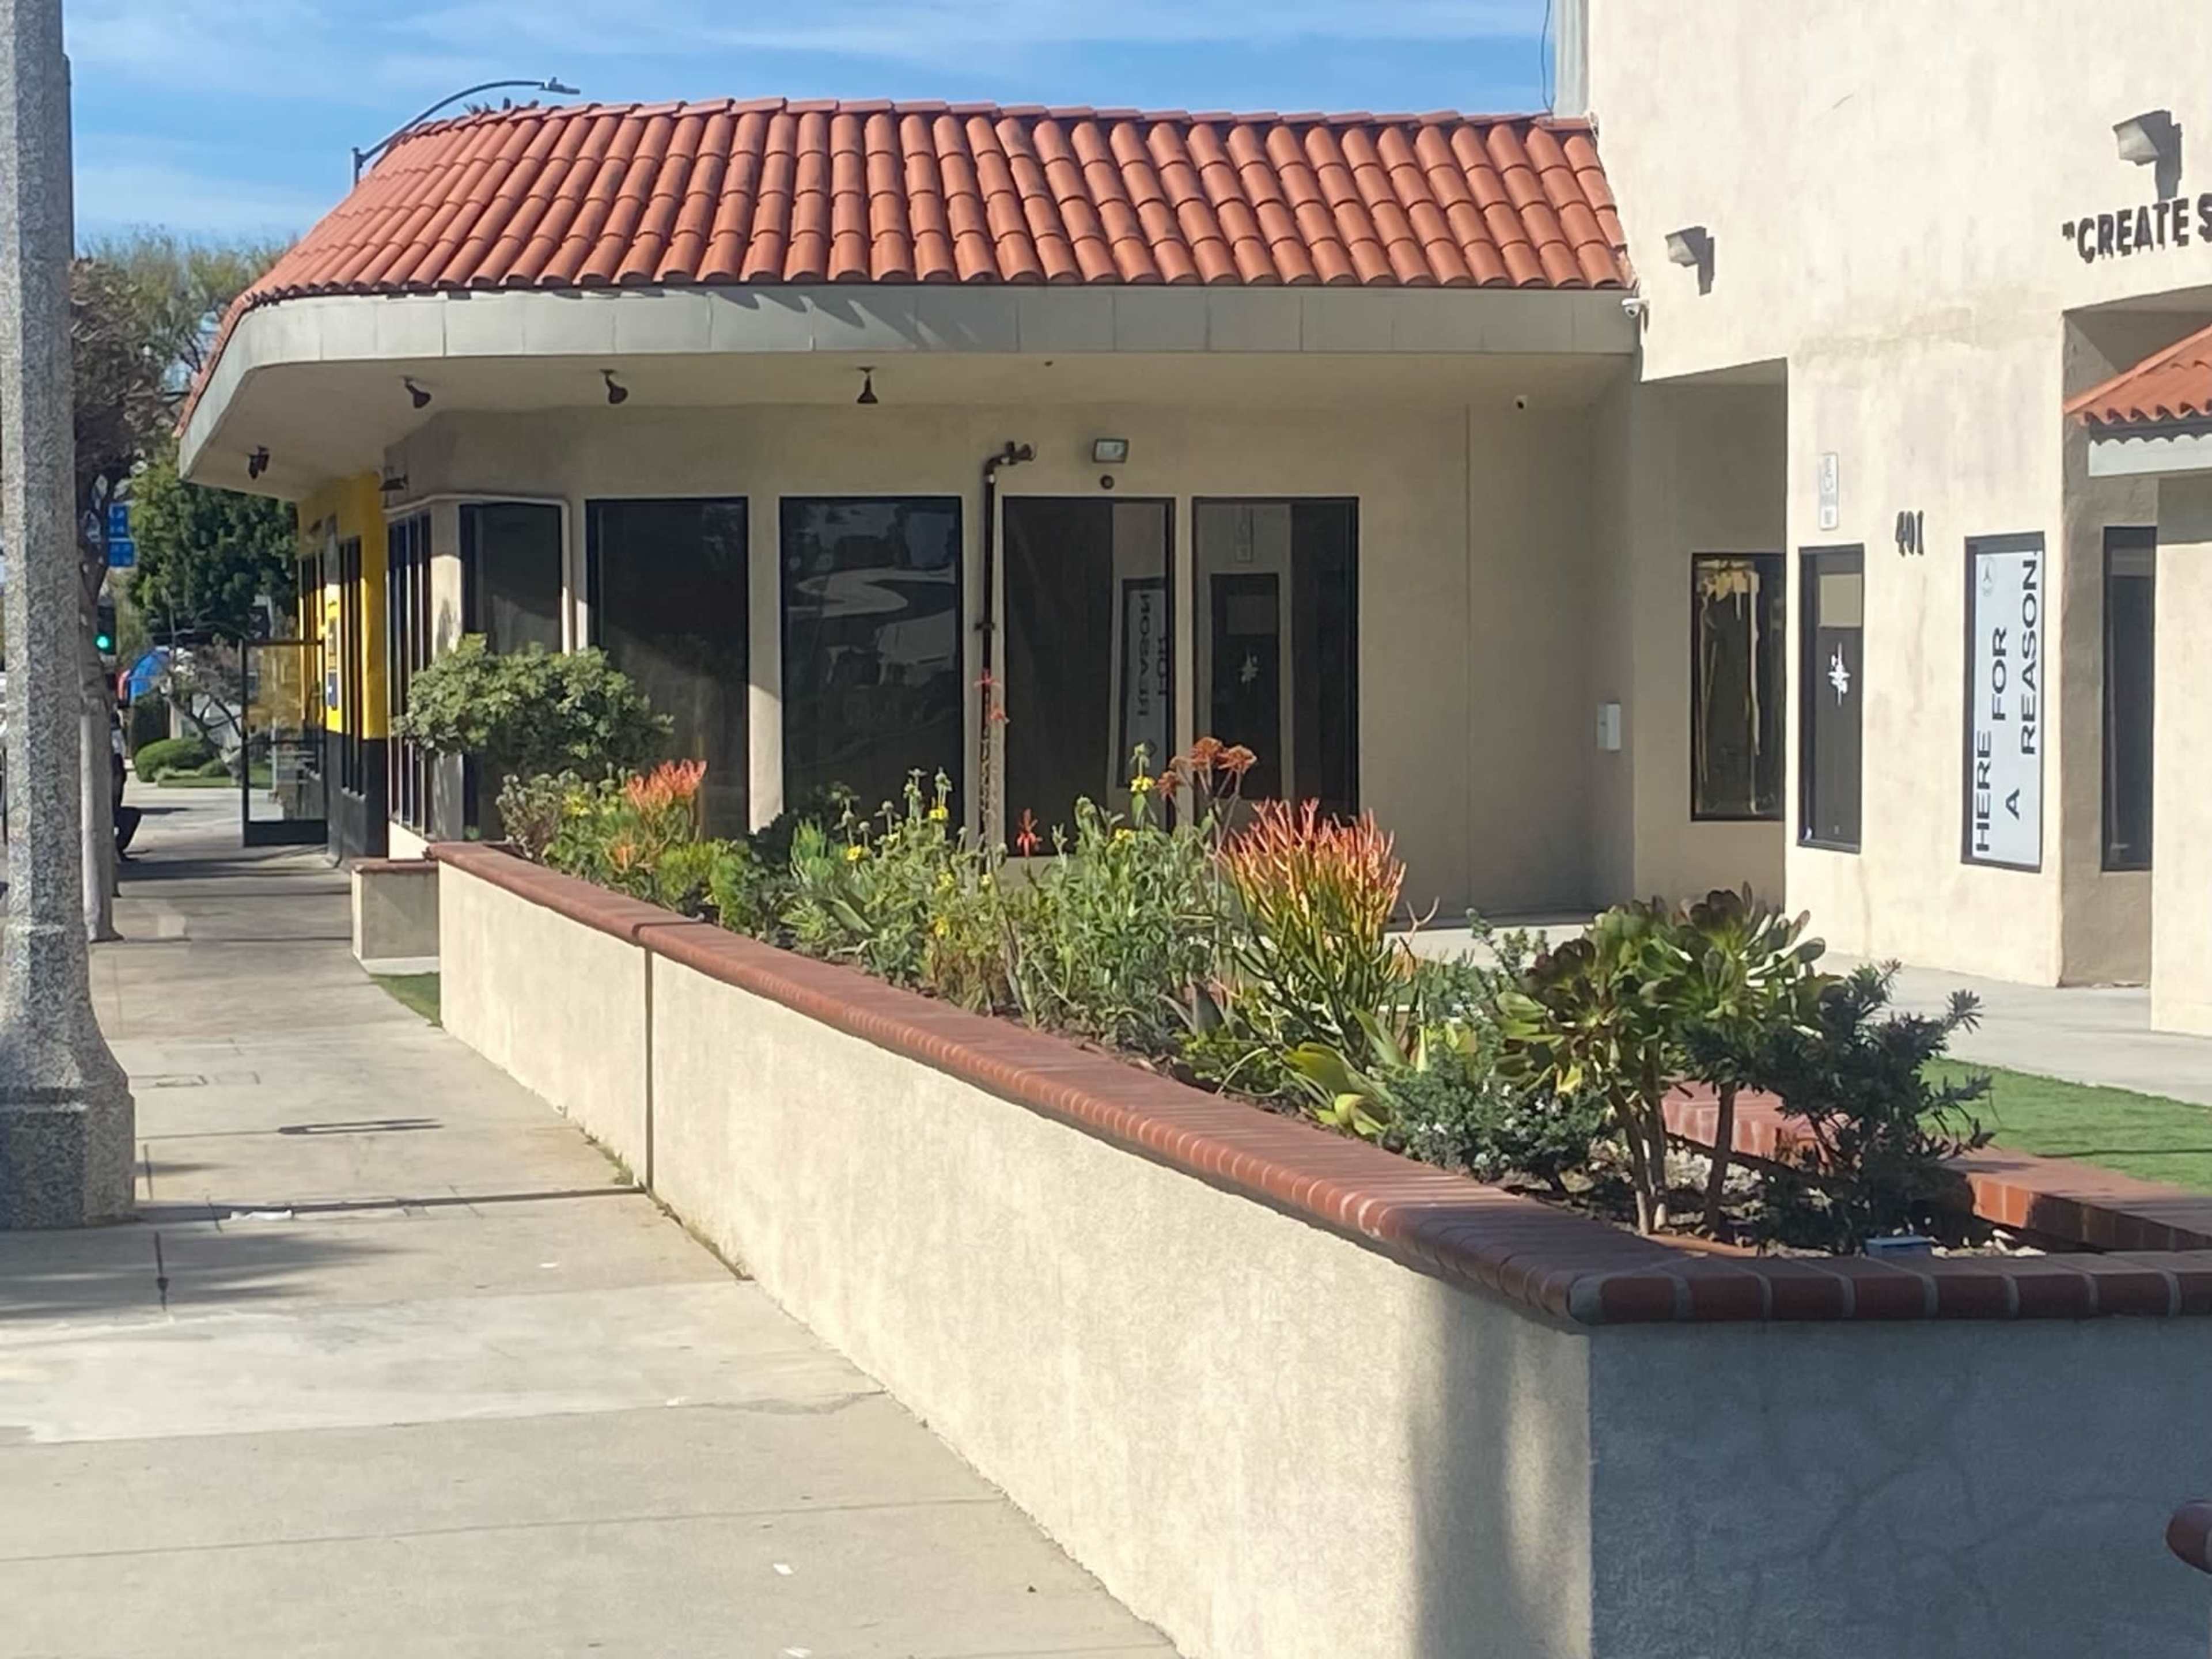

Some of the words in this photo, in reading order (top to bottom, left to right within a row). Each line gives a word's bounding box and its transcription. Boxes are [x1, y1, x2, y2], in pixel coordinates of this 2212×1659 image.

[1976, 730, 1991, 851] HERE
[1992, 627, 2006, 721] FOR
[2005, 788, 2020, 820] A
